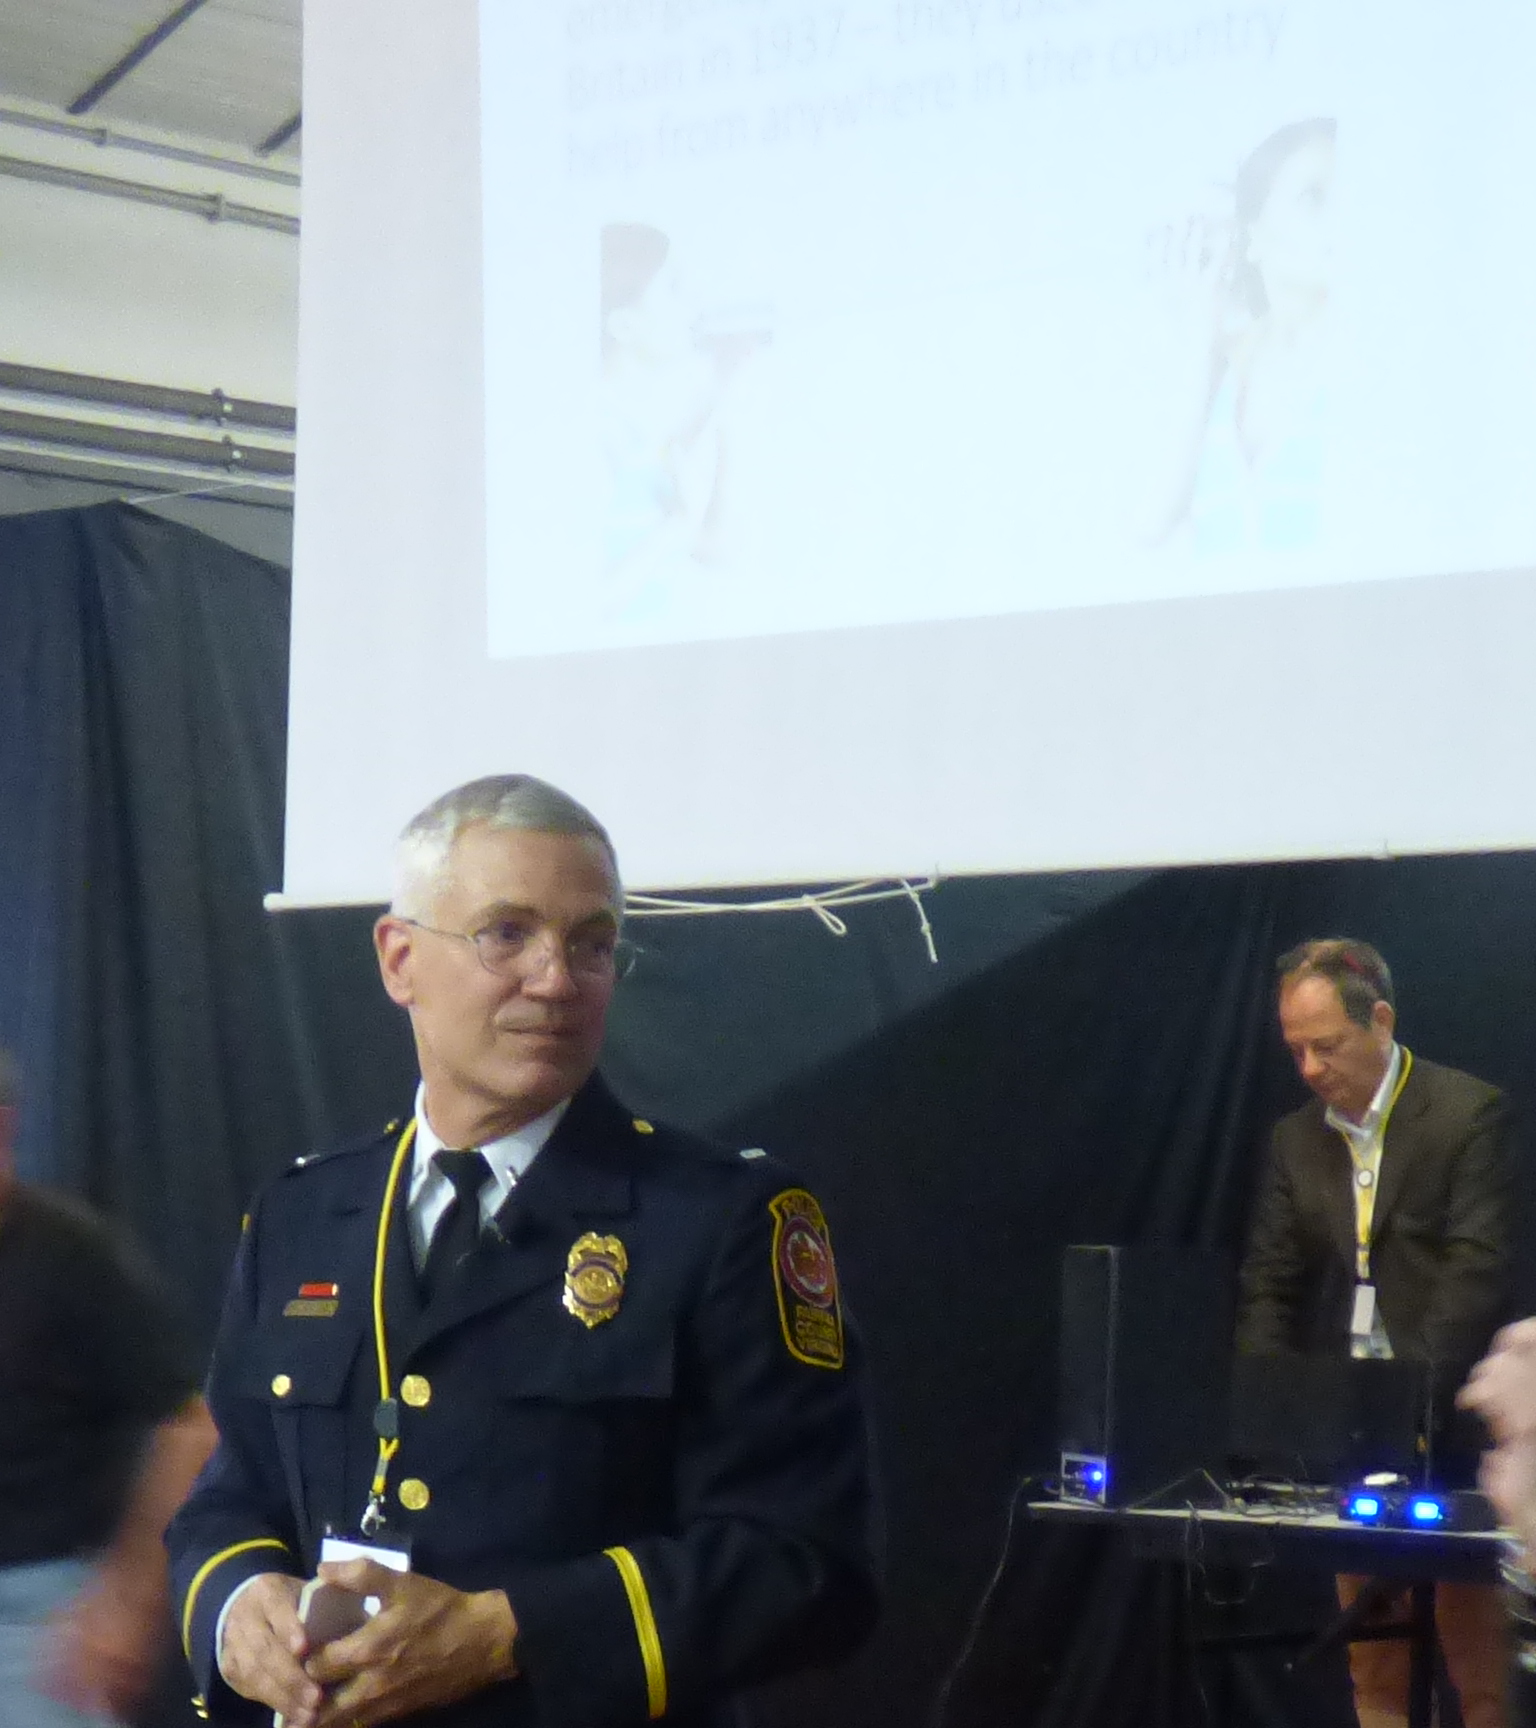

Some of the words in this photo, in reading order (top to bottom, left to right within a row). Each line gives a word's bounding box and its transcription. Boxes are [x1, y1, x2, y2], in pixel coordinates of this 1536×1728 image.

[565, 54, 685, 112] Britain
[699, 34, 734, 82] in
[748, 6, 846, 76] 1937
[891, 0, 985, 45] they
[565, 130, 644, 180] help
[657, 109, 749, 159] from
[759, 69, 958, 148] anywhere
[971, 54, 1010, 103] in
[1024, 38, 1094, 95] the
[1107, 4, 1289, 79] country
